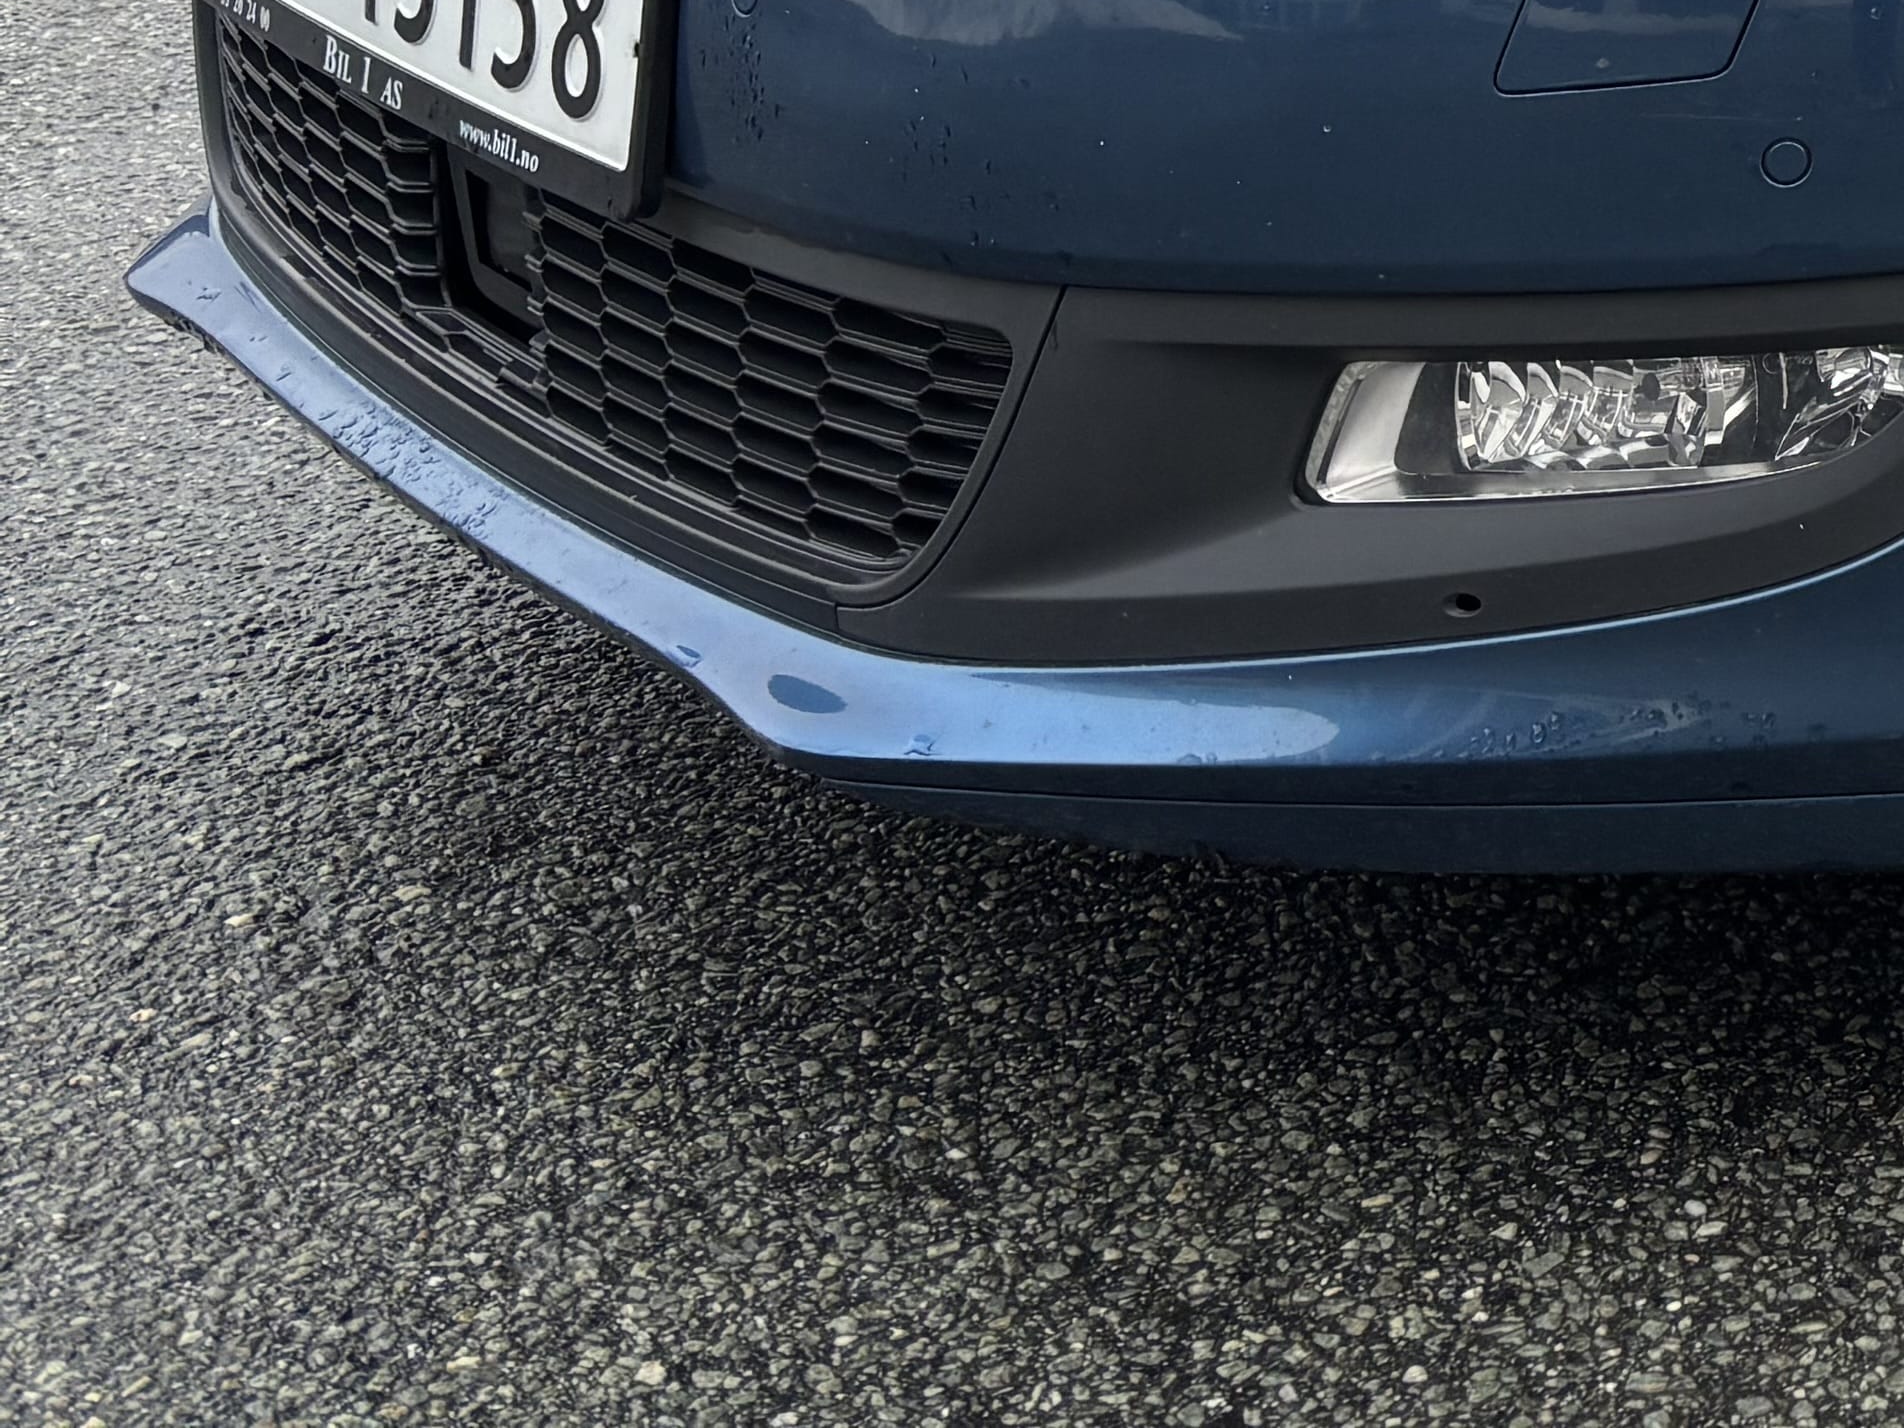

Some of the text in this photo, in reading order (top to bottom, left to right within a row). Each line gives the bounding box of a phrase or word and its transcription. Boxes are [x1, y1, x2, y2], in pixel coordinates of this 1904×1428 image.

[361, 56, 372, 94] 1
[379, 77, 404, 110] AS
[458, 117, 541, 172] www.bil1.no
